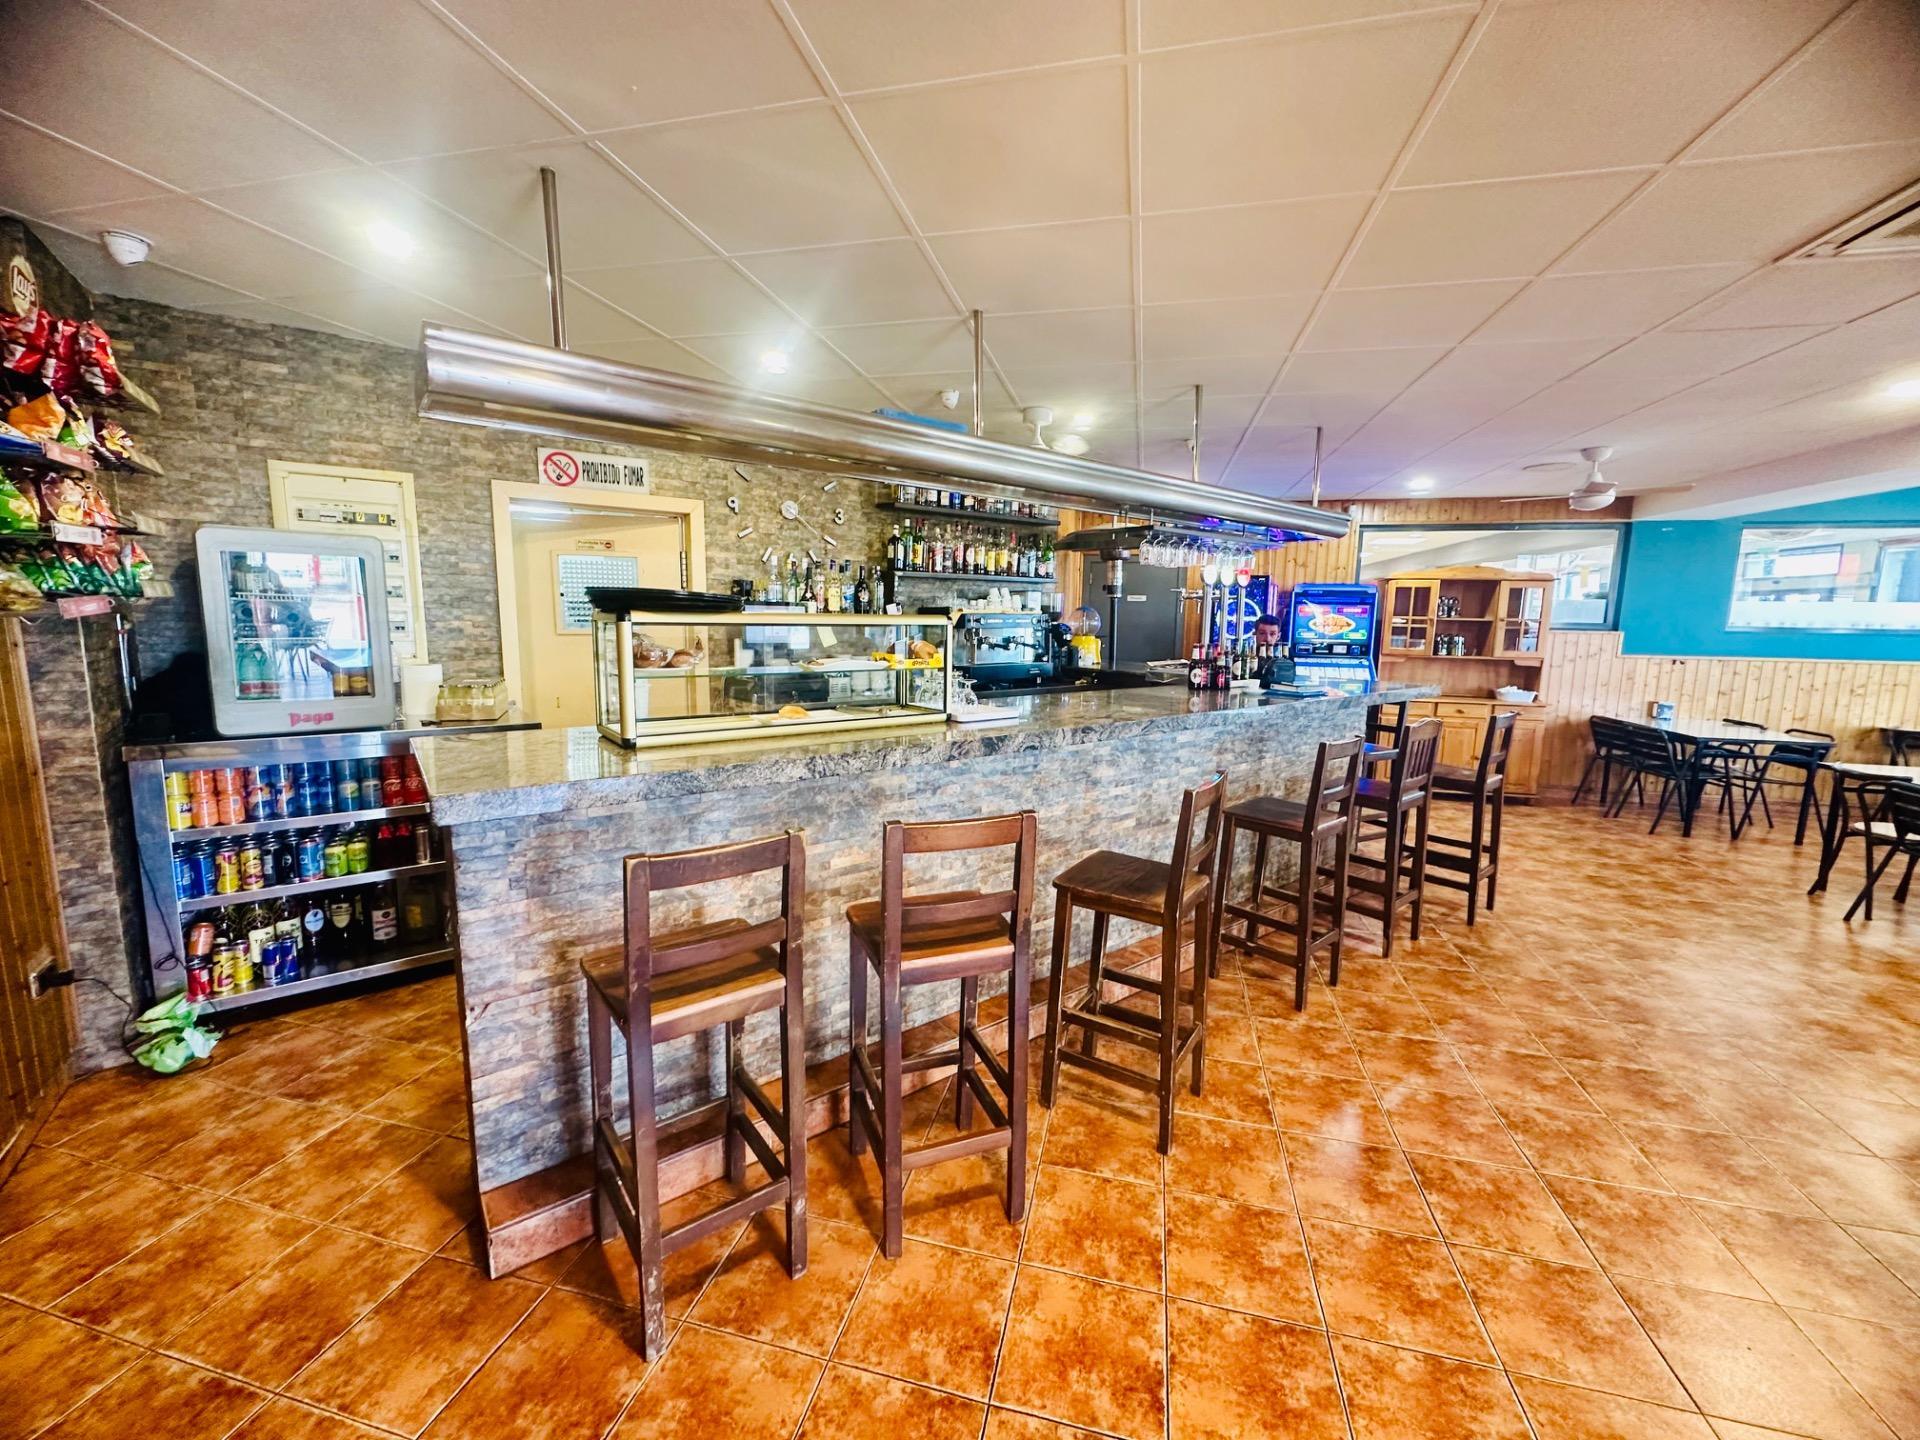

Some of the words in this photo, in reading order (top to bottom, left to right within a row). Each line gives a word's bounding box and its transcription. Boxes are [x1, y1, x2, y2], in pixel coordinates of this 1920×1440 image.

[581, 460, 621, 485] PROHIBIDO
[623, 465, 645, 487] FUMAR
[727, 496, 739, 514] 9
[834, 508, 845, 525] 3
